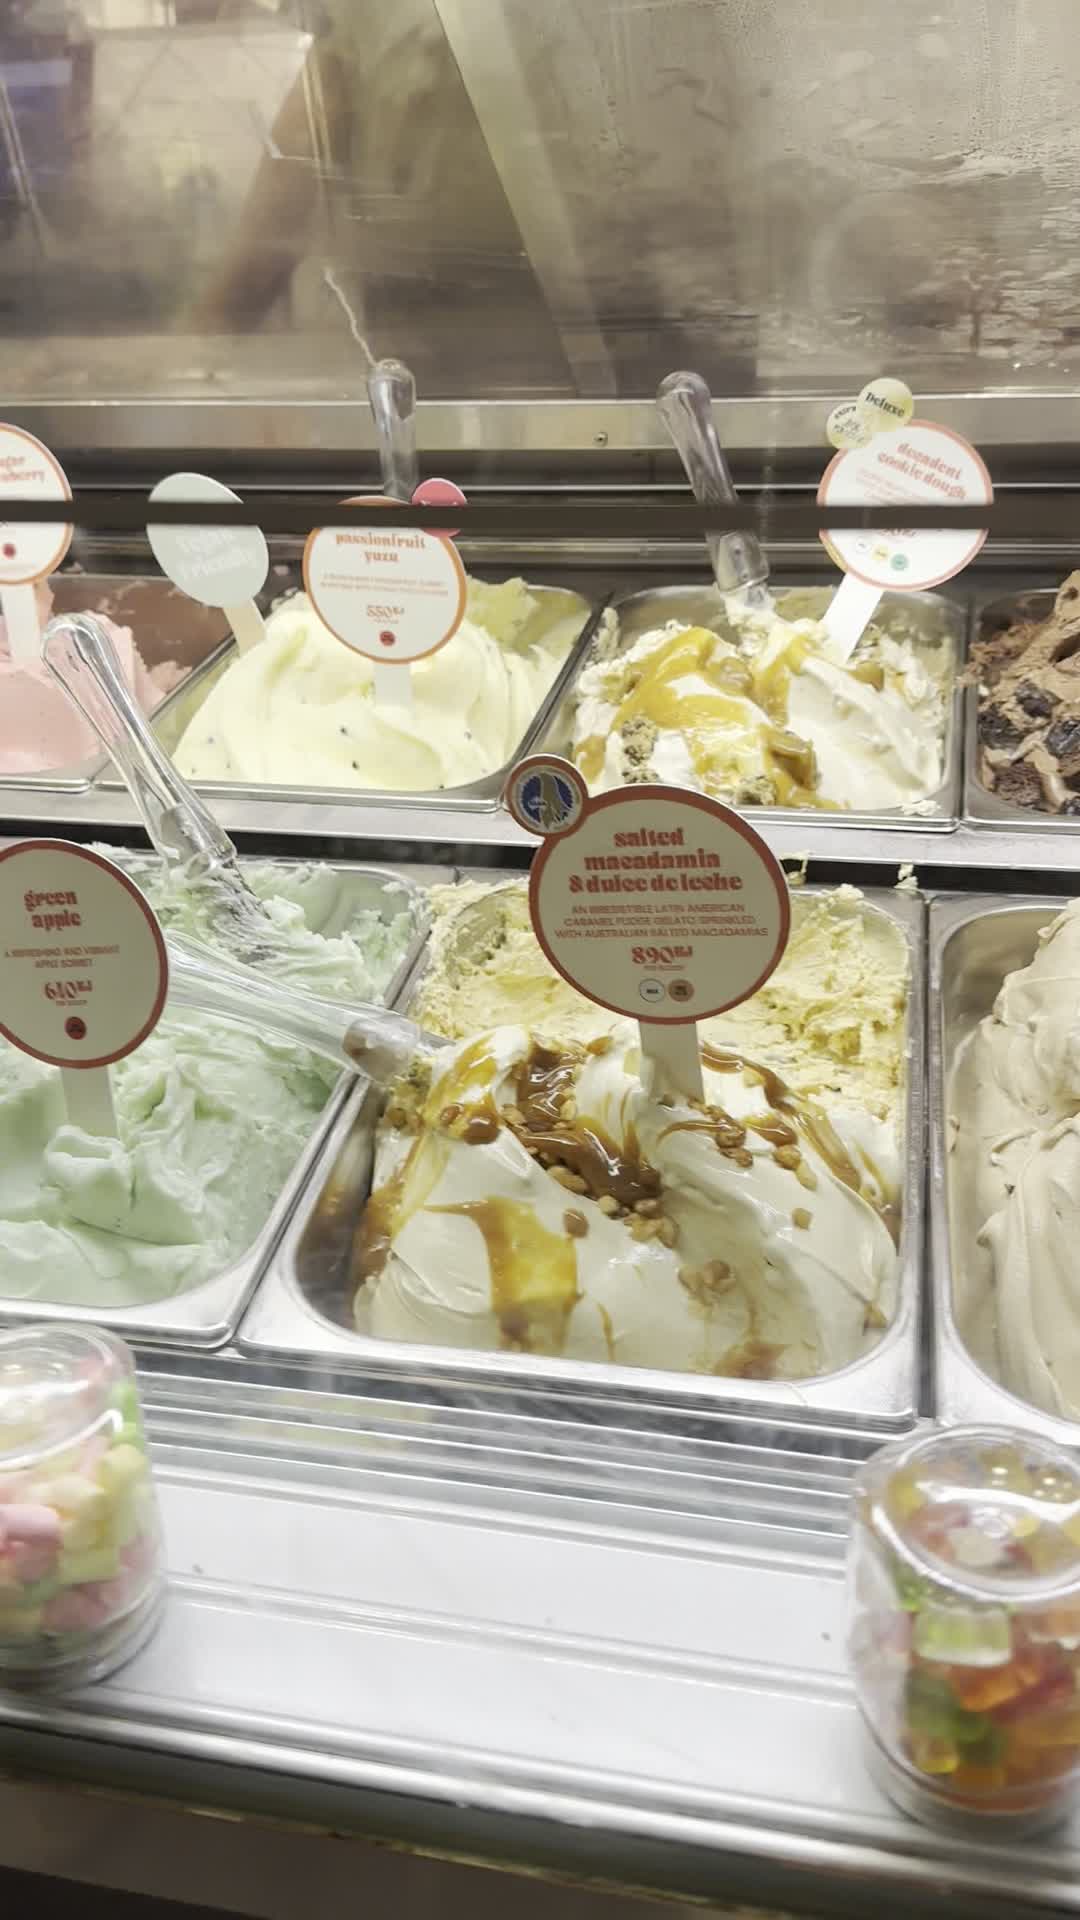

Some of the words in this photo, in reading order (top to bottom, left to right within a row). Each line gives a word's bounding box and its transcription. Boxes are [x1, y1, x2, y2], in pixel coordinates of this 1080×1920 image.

[866, 392, 905, 418] Deluxe
[923, 469, 966, 500] dough
[335, 531, 426, 549] passionfruit
[364, 551, 398, 564] yuzu
[613, 827, 684, 848] salted
[584, 848, 721, 871] macadamia
[586, 874, 648, 893] dulce
[650, 874, 678, 892] de
[680, 872, 743, 892] leche
[24, 890, 78, 912] green
[572, 905, 585, 914] AN
[589, 904, 654, 914] IRRESISTIBLE
[655, 904, 684, 914] LATIN
[687, 903, 745, 913] AMERICAN
[32, 909, 82, 931] apple
[564, 917, 613, 927] CARAMEL
[616, 916, 650, 926] FUDGE
[653, 916, 696, 926] GELATO
[699, 915, 757, 925] SPRINKLED
[554, 929, 582, 939] WITH
[585, 928, 649, 938] AUSTRALIAN
[651, 928, 688, 938] SALTED
[691, 927, 769, 937] MACADAMIAS
